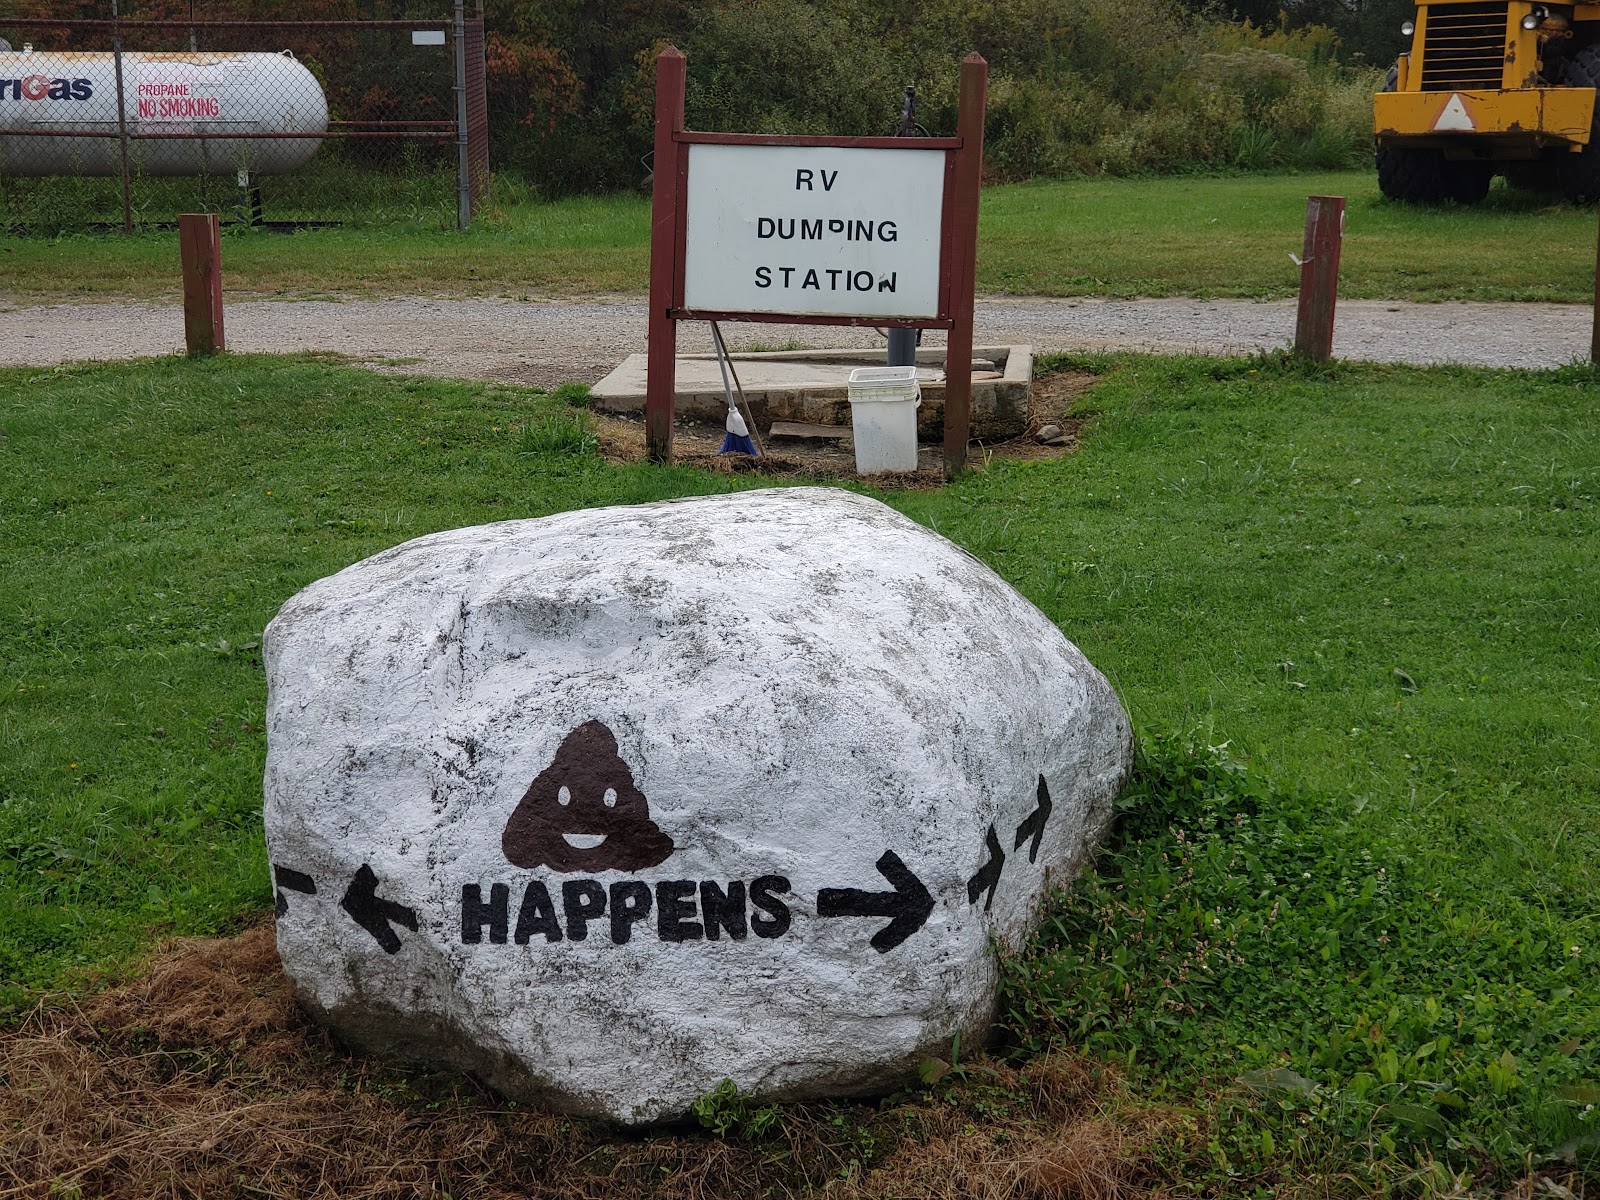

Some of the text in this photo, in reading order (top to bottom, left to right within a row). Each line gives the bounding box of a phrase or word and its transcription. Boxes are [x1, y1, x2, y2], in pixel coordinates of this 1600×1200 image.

[138, 84, 190, 96] PROPANE
[138, 97, 219, 117] NO SMOKING
[796, 169, 838, 191] RV
[757, 217, 898, 242] DUMPING
[754, 266, 897, 293] STATION
[461, 875, 792, 945] HAPPENS
